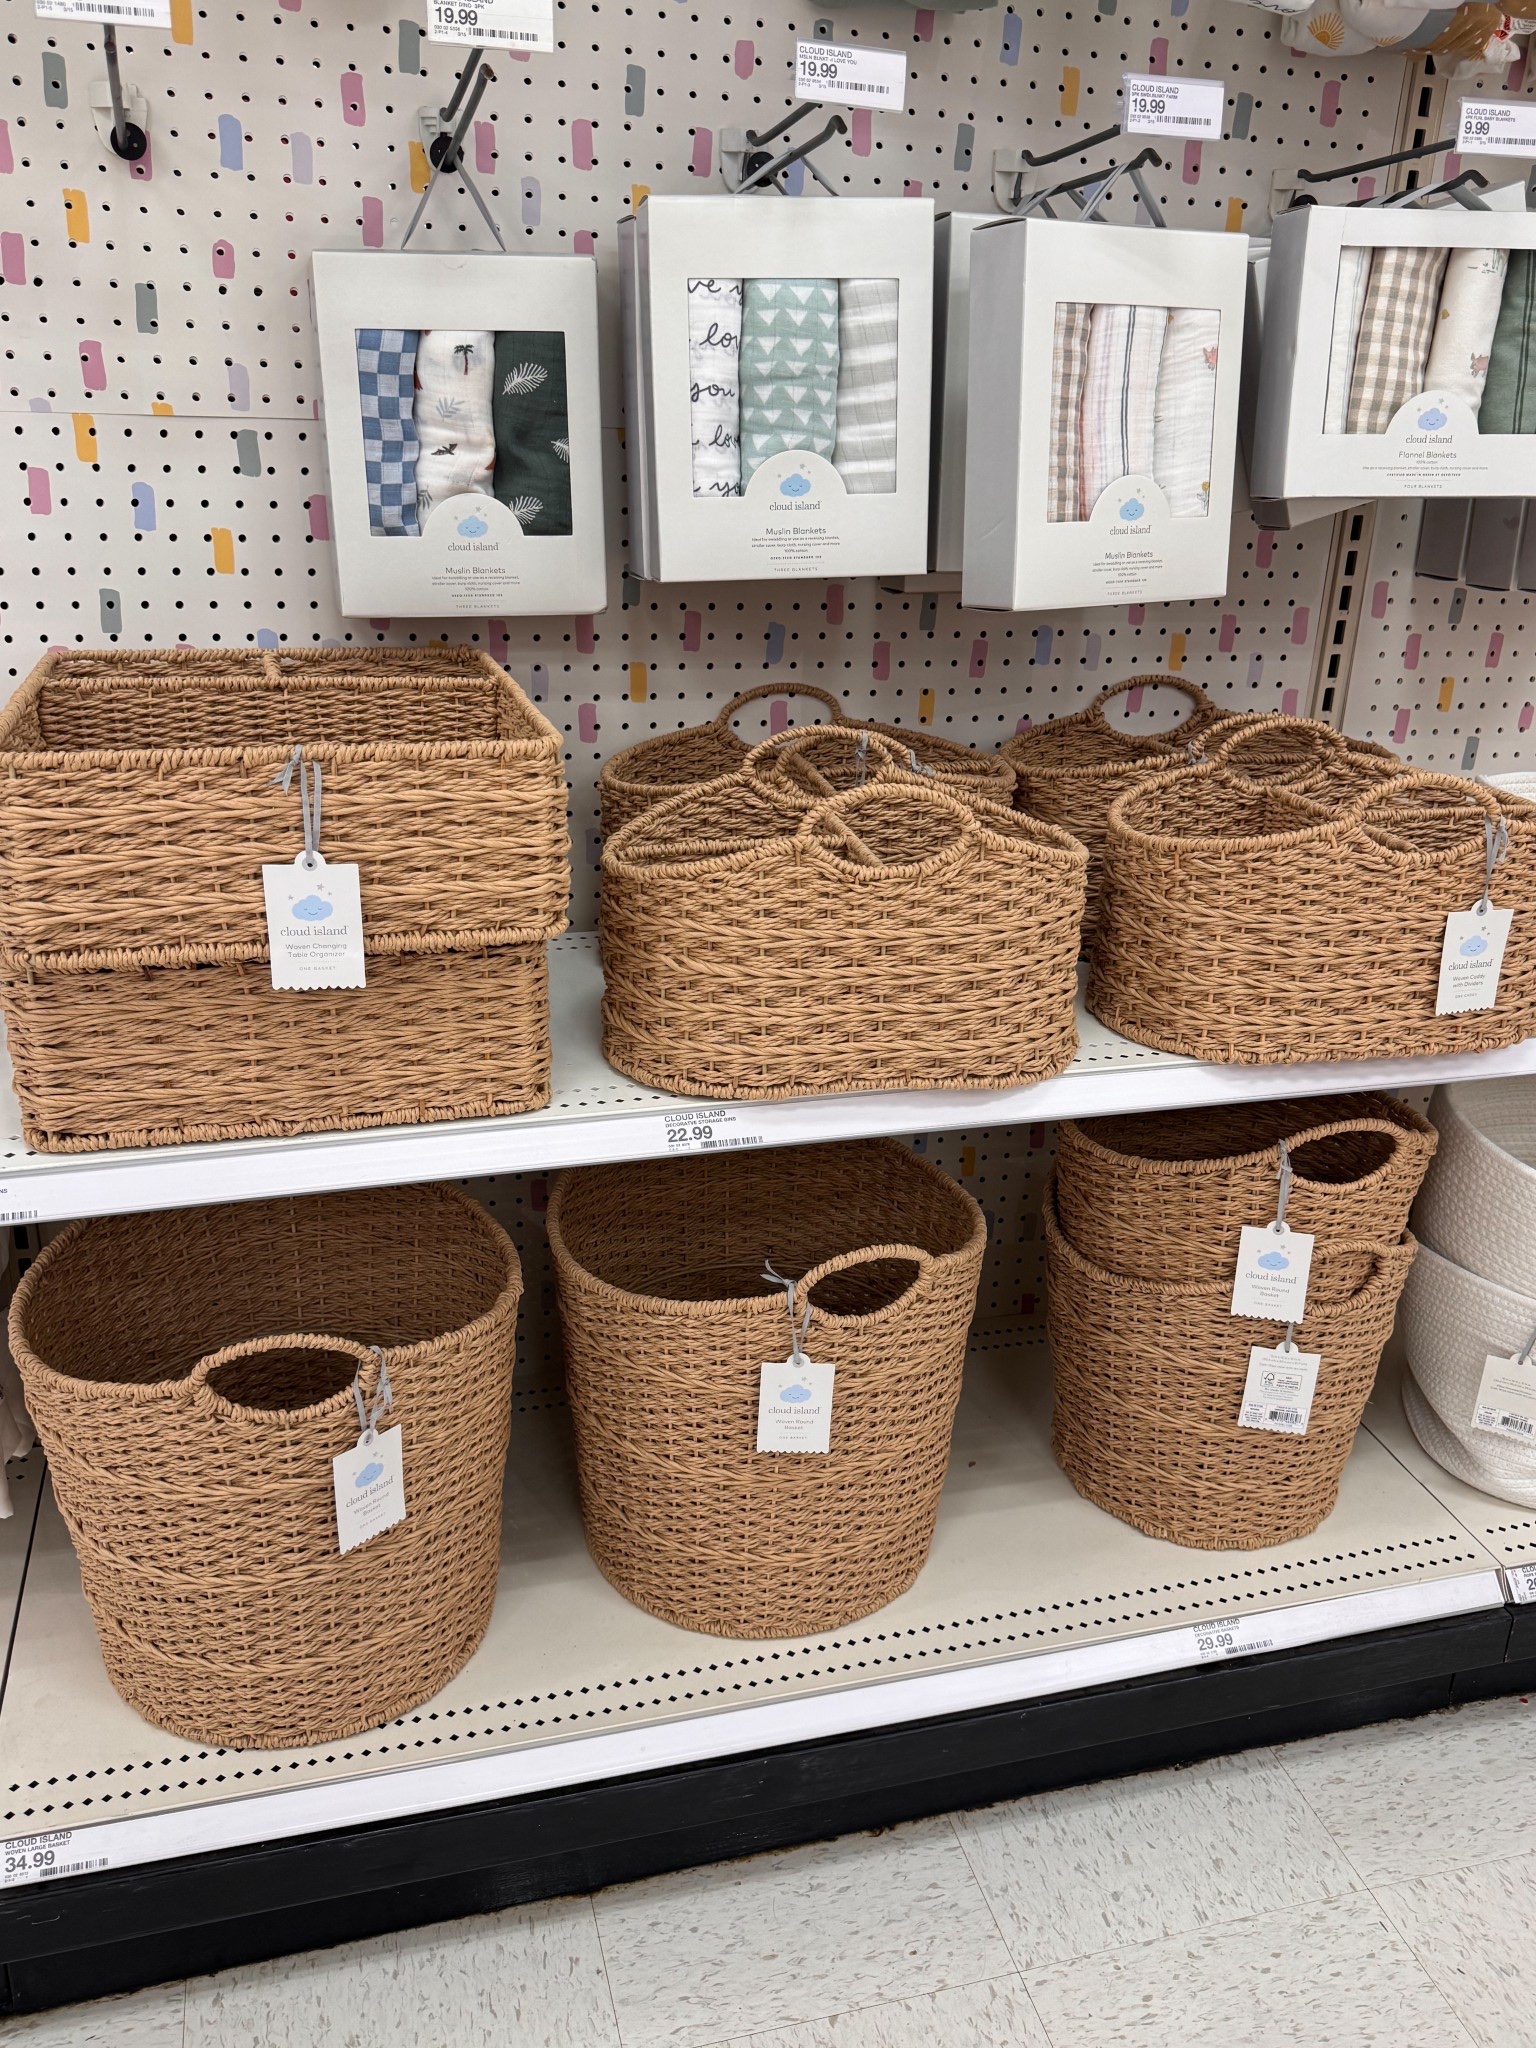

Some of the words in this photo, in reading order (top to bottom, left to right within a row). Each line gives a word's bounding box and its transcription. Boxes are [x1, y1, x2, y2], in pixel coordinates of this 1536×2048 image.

[435, 6, 478, 26] 19.99
[800, 46, 825, 55] CLOUD
[827, 49, 852, 58] ISLAND
[800, 61, 837, 79] 19.99
[1132, 84, 1154, 92] CLOUD
[1156, 86, 1179, 94] ISLAND
[1132, 98, 1165, 114] 19.99
[1466, 108, 1487, 116] CLOUD
[1464, 121, 1490, 135] 9.99
[690, 382, 735, 402] you
[1406, 435, 1427, 444] cloud
[1429, 435, 1453, 444] island
[770, 502, 792, 511] cloud
[795, 501, 820, 510] island
[1110, 526, 1128, 535] cloud
[1130, 525, 1151, 535] island
[448, 542, 471, 551] cloud
[473, 542, 499, 551] island
[1127, 551, 1153, 559] Blankets
[280, 926, 310, 936] cloud
[314, 926, 347, 936] island
[1448, 961, 1468, 971] cloud
[1470, 959, 1493, 970] island
[664, 1113, 693, 1122] CLOUD
[696, 1110, 726, 1120] ISLAND
[667, 1126, 712, 1142] 22.99
[1245, 1271, 1268, 1281] cloud
[1270, 1274, 1297, 1284] island
[768, 1406, 792, 1414] cloud
[346, 1490, 368, 1508] cloud
[370, 1475, 394, 1495] island
[353, 1502, 372, 1515] Woven
[1193, 1623, 1215, 1632] CLOUD
[1217, 1618, 1240, 1627] ISLAND
[1197, 1633, 1233, 1651] 29.99
[5, 1838, 37, 1850] CLOUD
[40, 1831, 72, 1843] ISLAND
[5, 1848, 26, 1856] WOVEN
[48, 1840, 70, 1848] BASKET
[5, 1850, 55, 1873] 34.99
